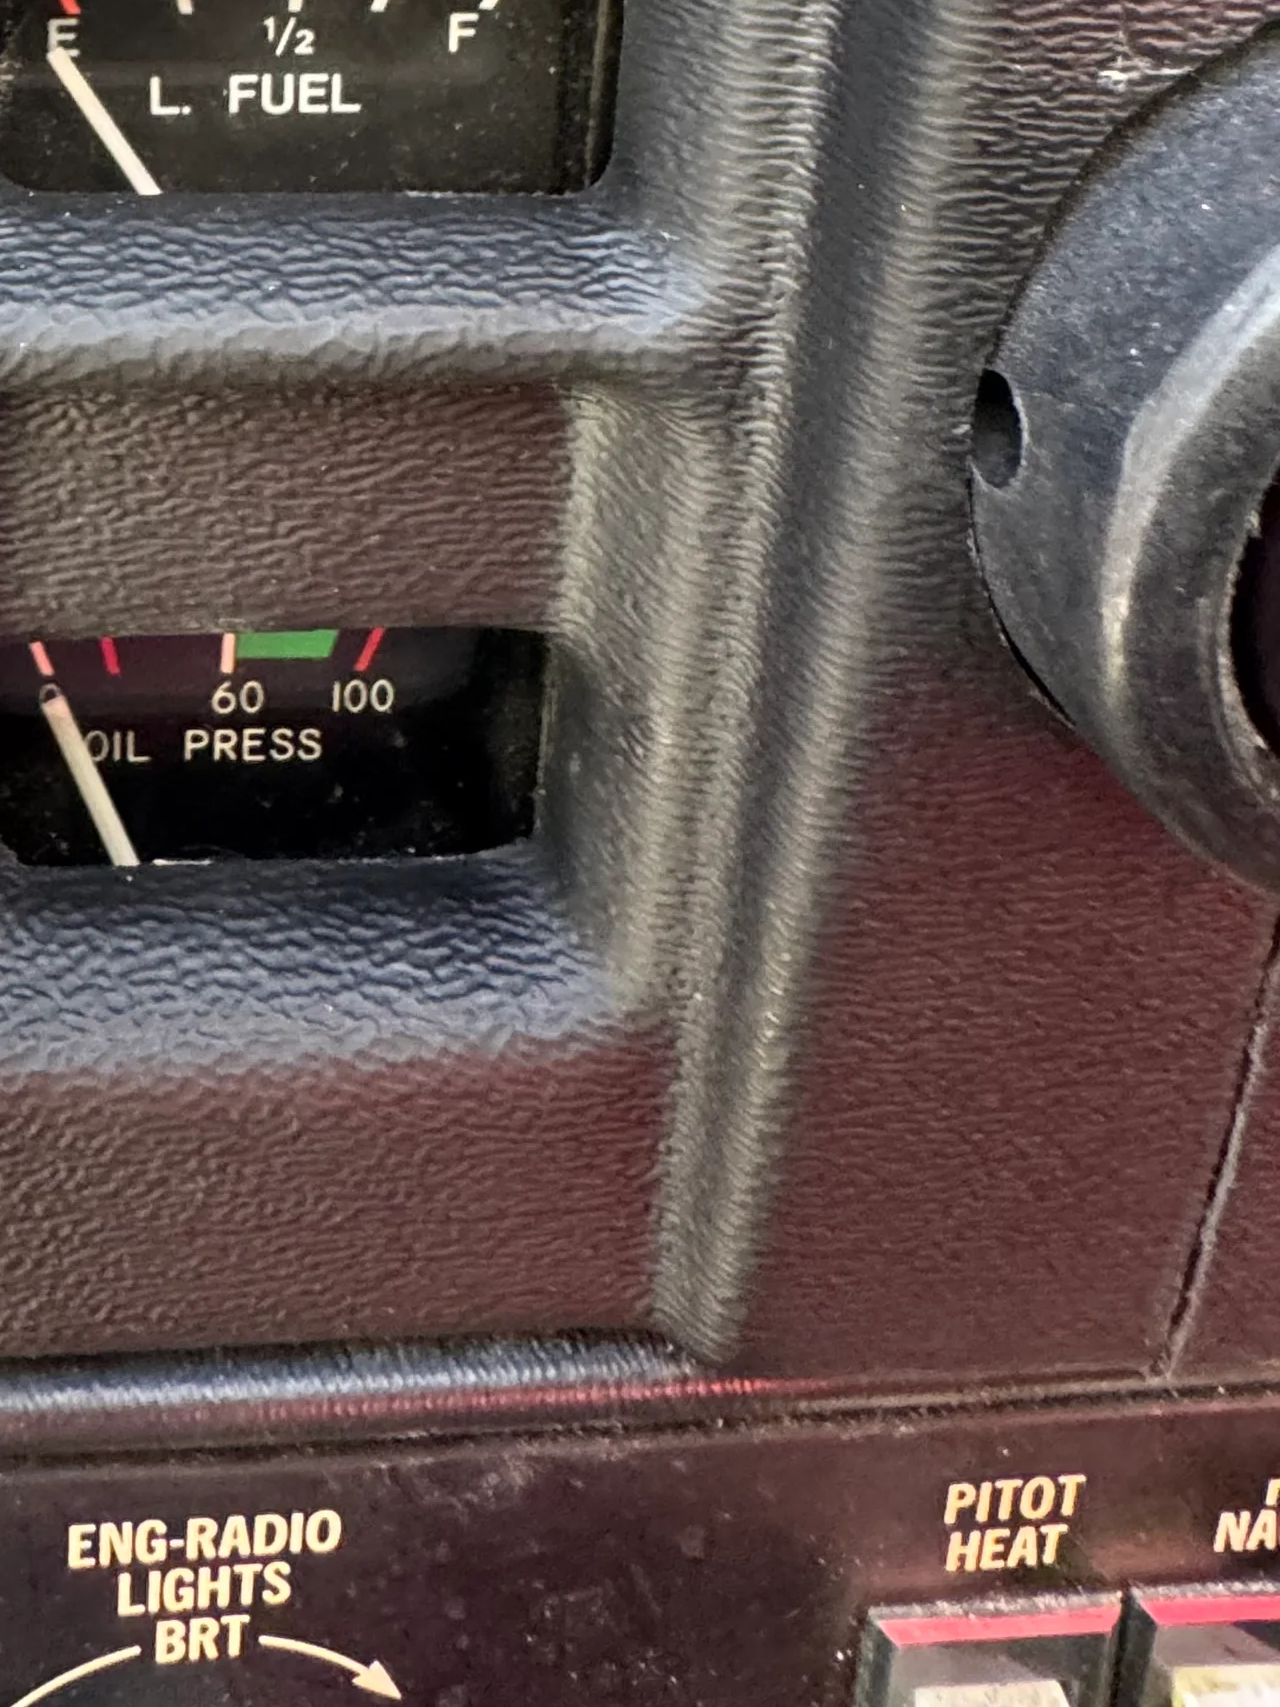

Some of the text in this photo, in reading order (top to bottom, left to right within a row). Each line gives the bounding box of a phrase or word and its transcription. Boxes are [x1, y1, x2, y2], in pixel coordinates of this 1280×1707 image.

[46, 17, 81, 59] E
[447, 12, 480, 54] F
[148, 72, 362, 116] L. FUEL
[210, 679, 265, 715] 60
[332, 678, 395, 714] 100
[83, 727, 323, 763] OIL PRESS
[943, 1472, 1087, 1526] PITOT
[67, 1508, 343, 1572] ENG-RADIO
[945, 1522, 1070, 1573] HEAT
[116, 1561, 293, 1619] LIGHTS
[154, 1614, 251, 1665] BRT
